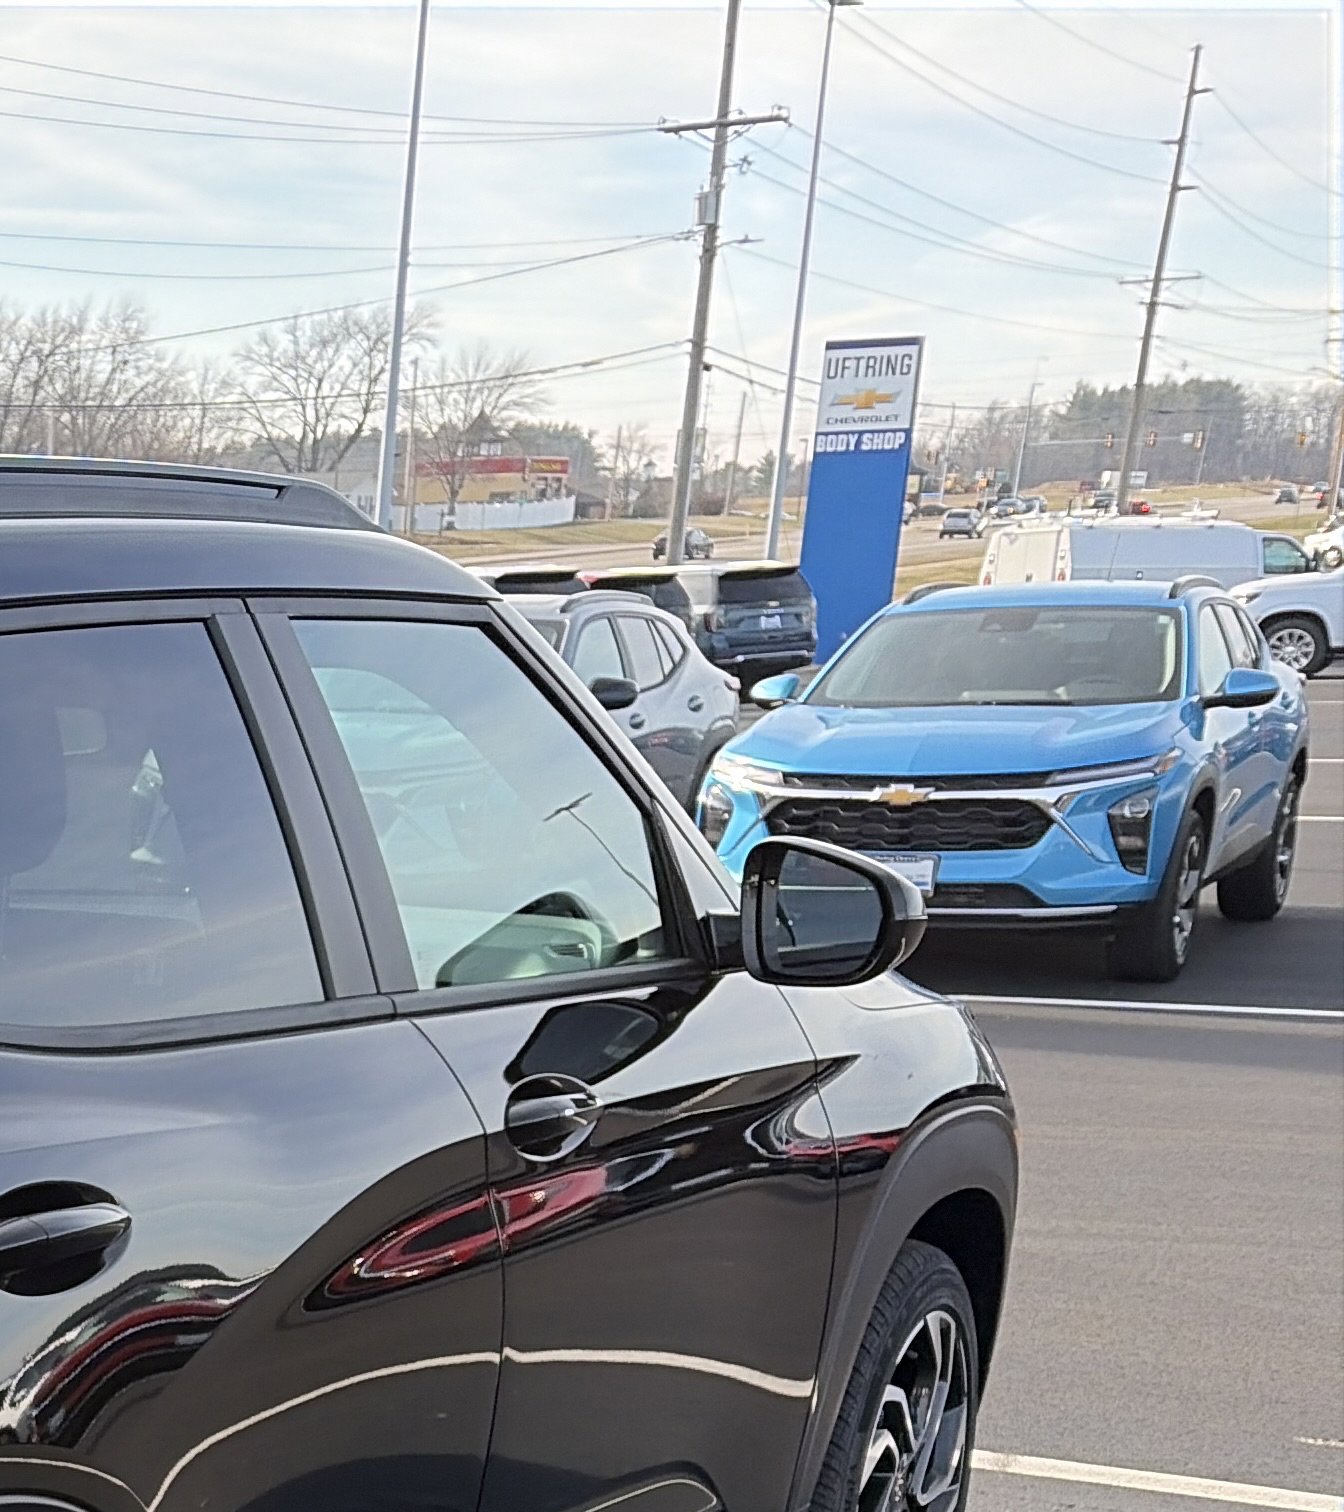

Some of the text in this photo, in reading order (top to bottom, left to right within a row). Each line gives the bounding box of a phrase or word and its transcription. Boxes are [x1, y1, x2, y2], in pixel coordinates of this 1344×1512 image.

[826, 353, 913, 379] UFTRING
[825, 414, 900, 425] CHEVROLET
[815, 431, 906, 453] BODY SHOP
